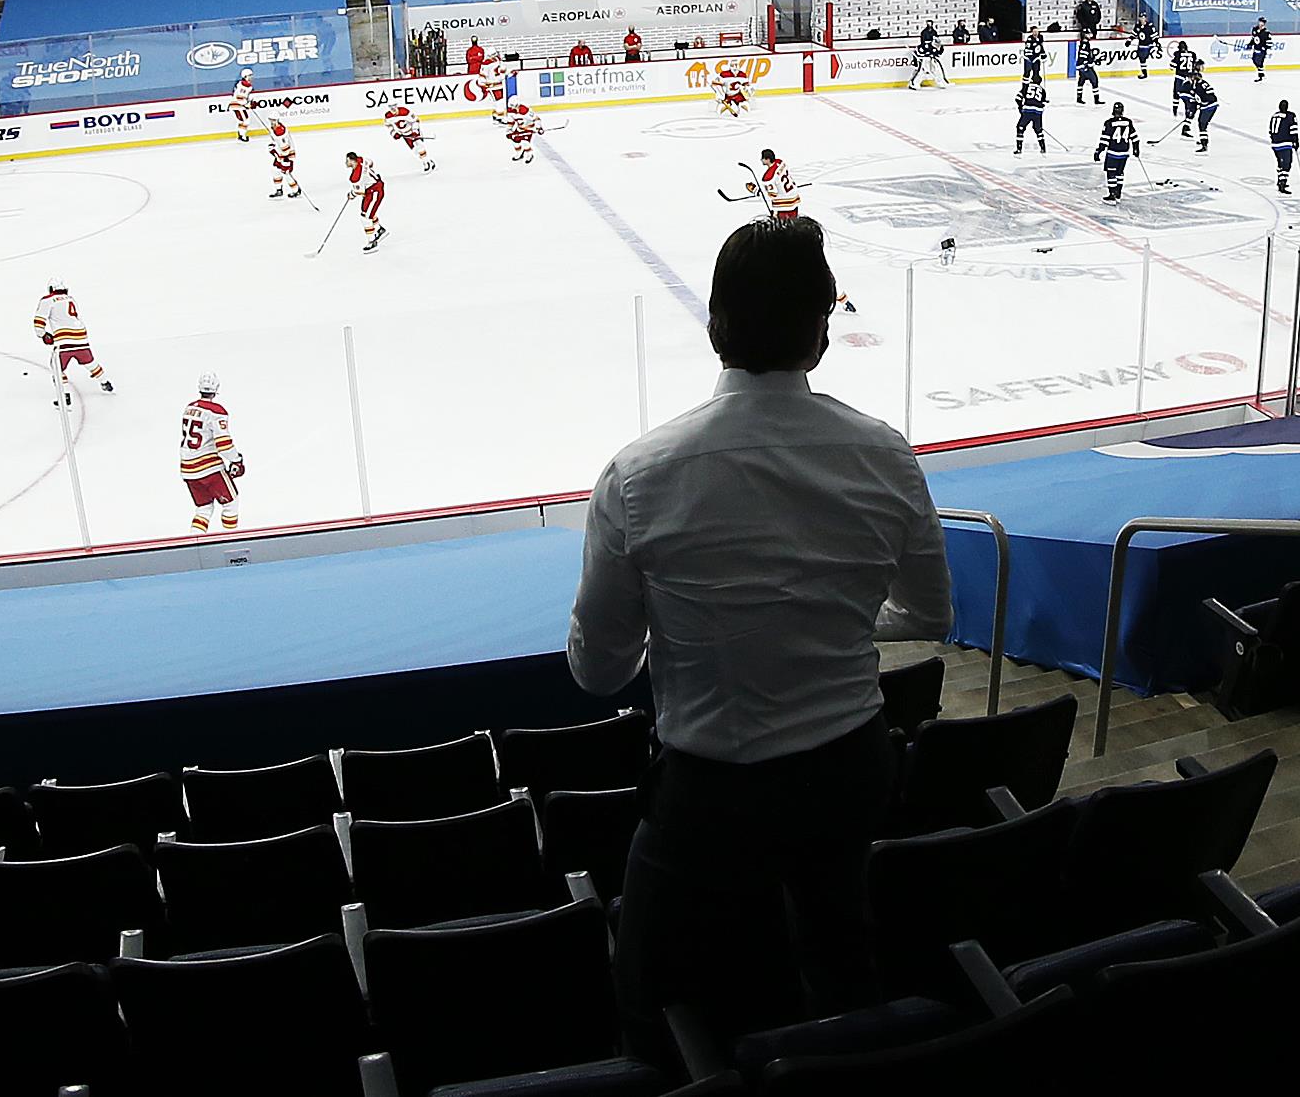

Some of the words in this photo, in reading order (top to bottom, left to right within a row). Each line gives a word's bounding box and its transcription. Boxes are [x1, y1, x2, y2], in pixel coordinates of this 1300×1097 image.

[541, 9, 611, 22] AEROPLAN
[655, 4, 723, 15] AEROPLAN
[424, 17, 495, 31] AEROPLAN
[238, 35, 318, 53] JETS
[16, 50, 141, 75] TrueNorth
[237, 48, 319, 65] GEAR
[11, 64, 140, 89] SHOP.COM
[567, 68, 645, 87] staffmax
[365, 83, 459, 108] SAFEWAY
[1026, 86, 1043, 102] 55
[83, 112, 141, 129] BOYD
[1112, 126, 1130, 143] 44
